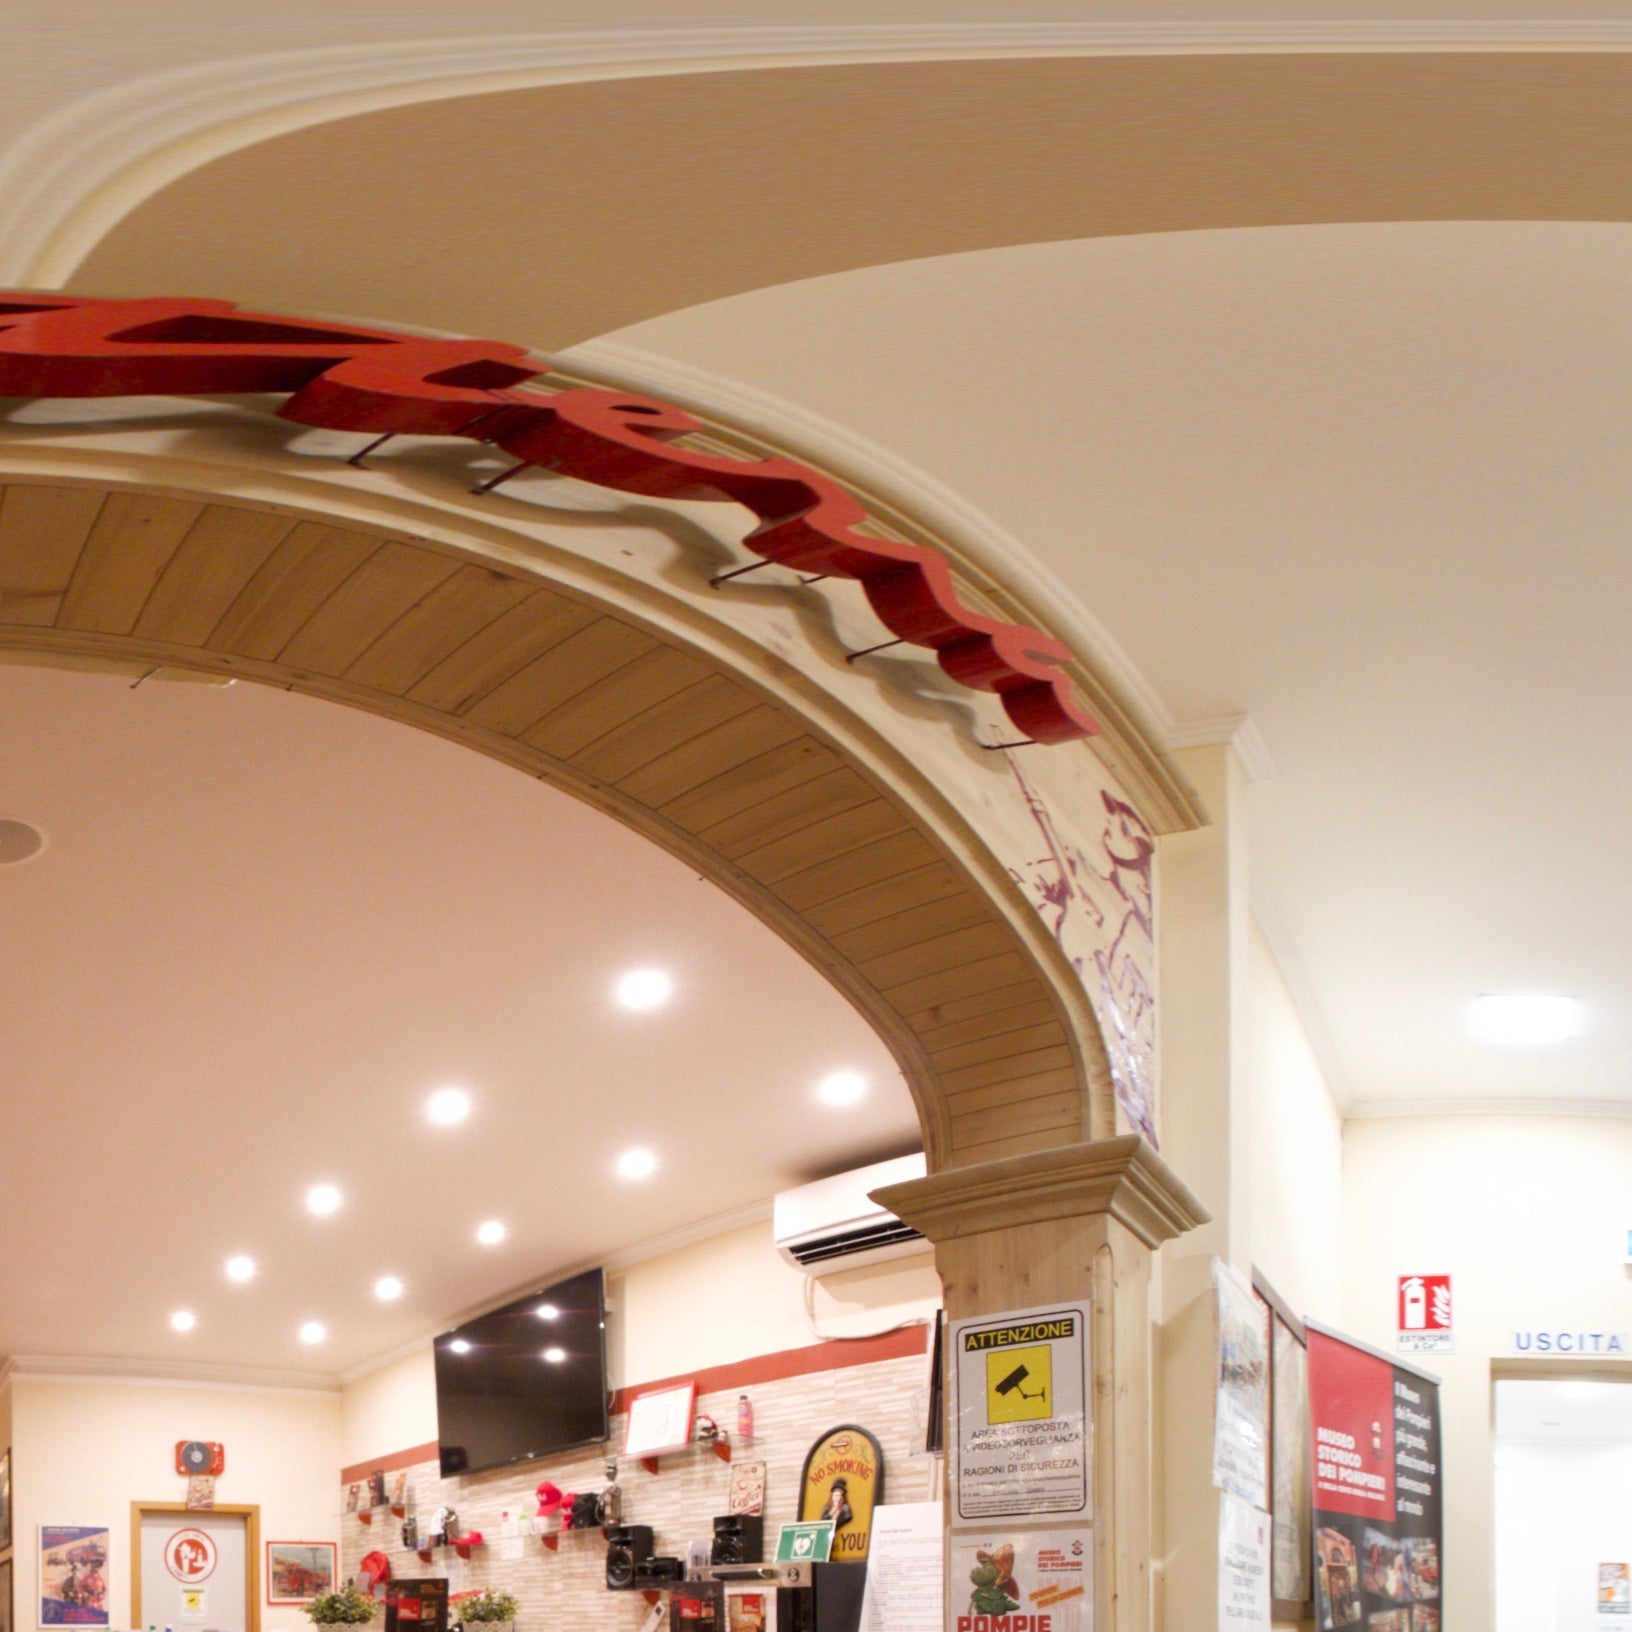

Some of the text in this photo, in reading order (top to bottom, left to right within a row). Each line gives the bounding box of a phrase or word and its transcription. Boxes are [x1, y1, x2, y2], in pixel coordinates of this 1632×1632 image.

[966, 1321, 1072, 1350] ATTENZIONE
[1515, 1332, 1624, 1353] USCITA
[1317, 1427, 1355, 1450] MUSEO
[964, 1459, 1079, 1476] RAGIONI DI SICUREZZA
[1317, 1444, 1362, 1468] STORICO
[809, 1459, 873, 1486] NO SMOKING
[1318, 1462, 1386, 1490] DEI POMPIERI
[841, 1532, 866, 1552] YOU
